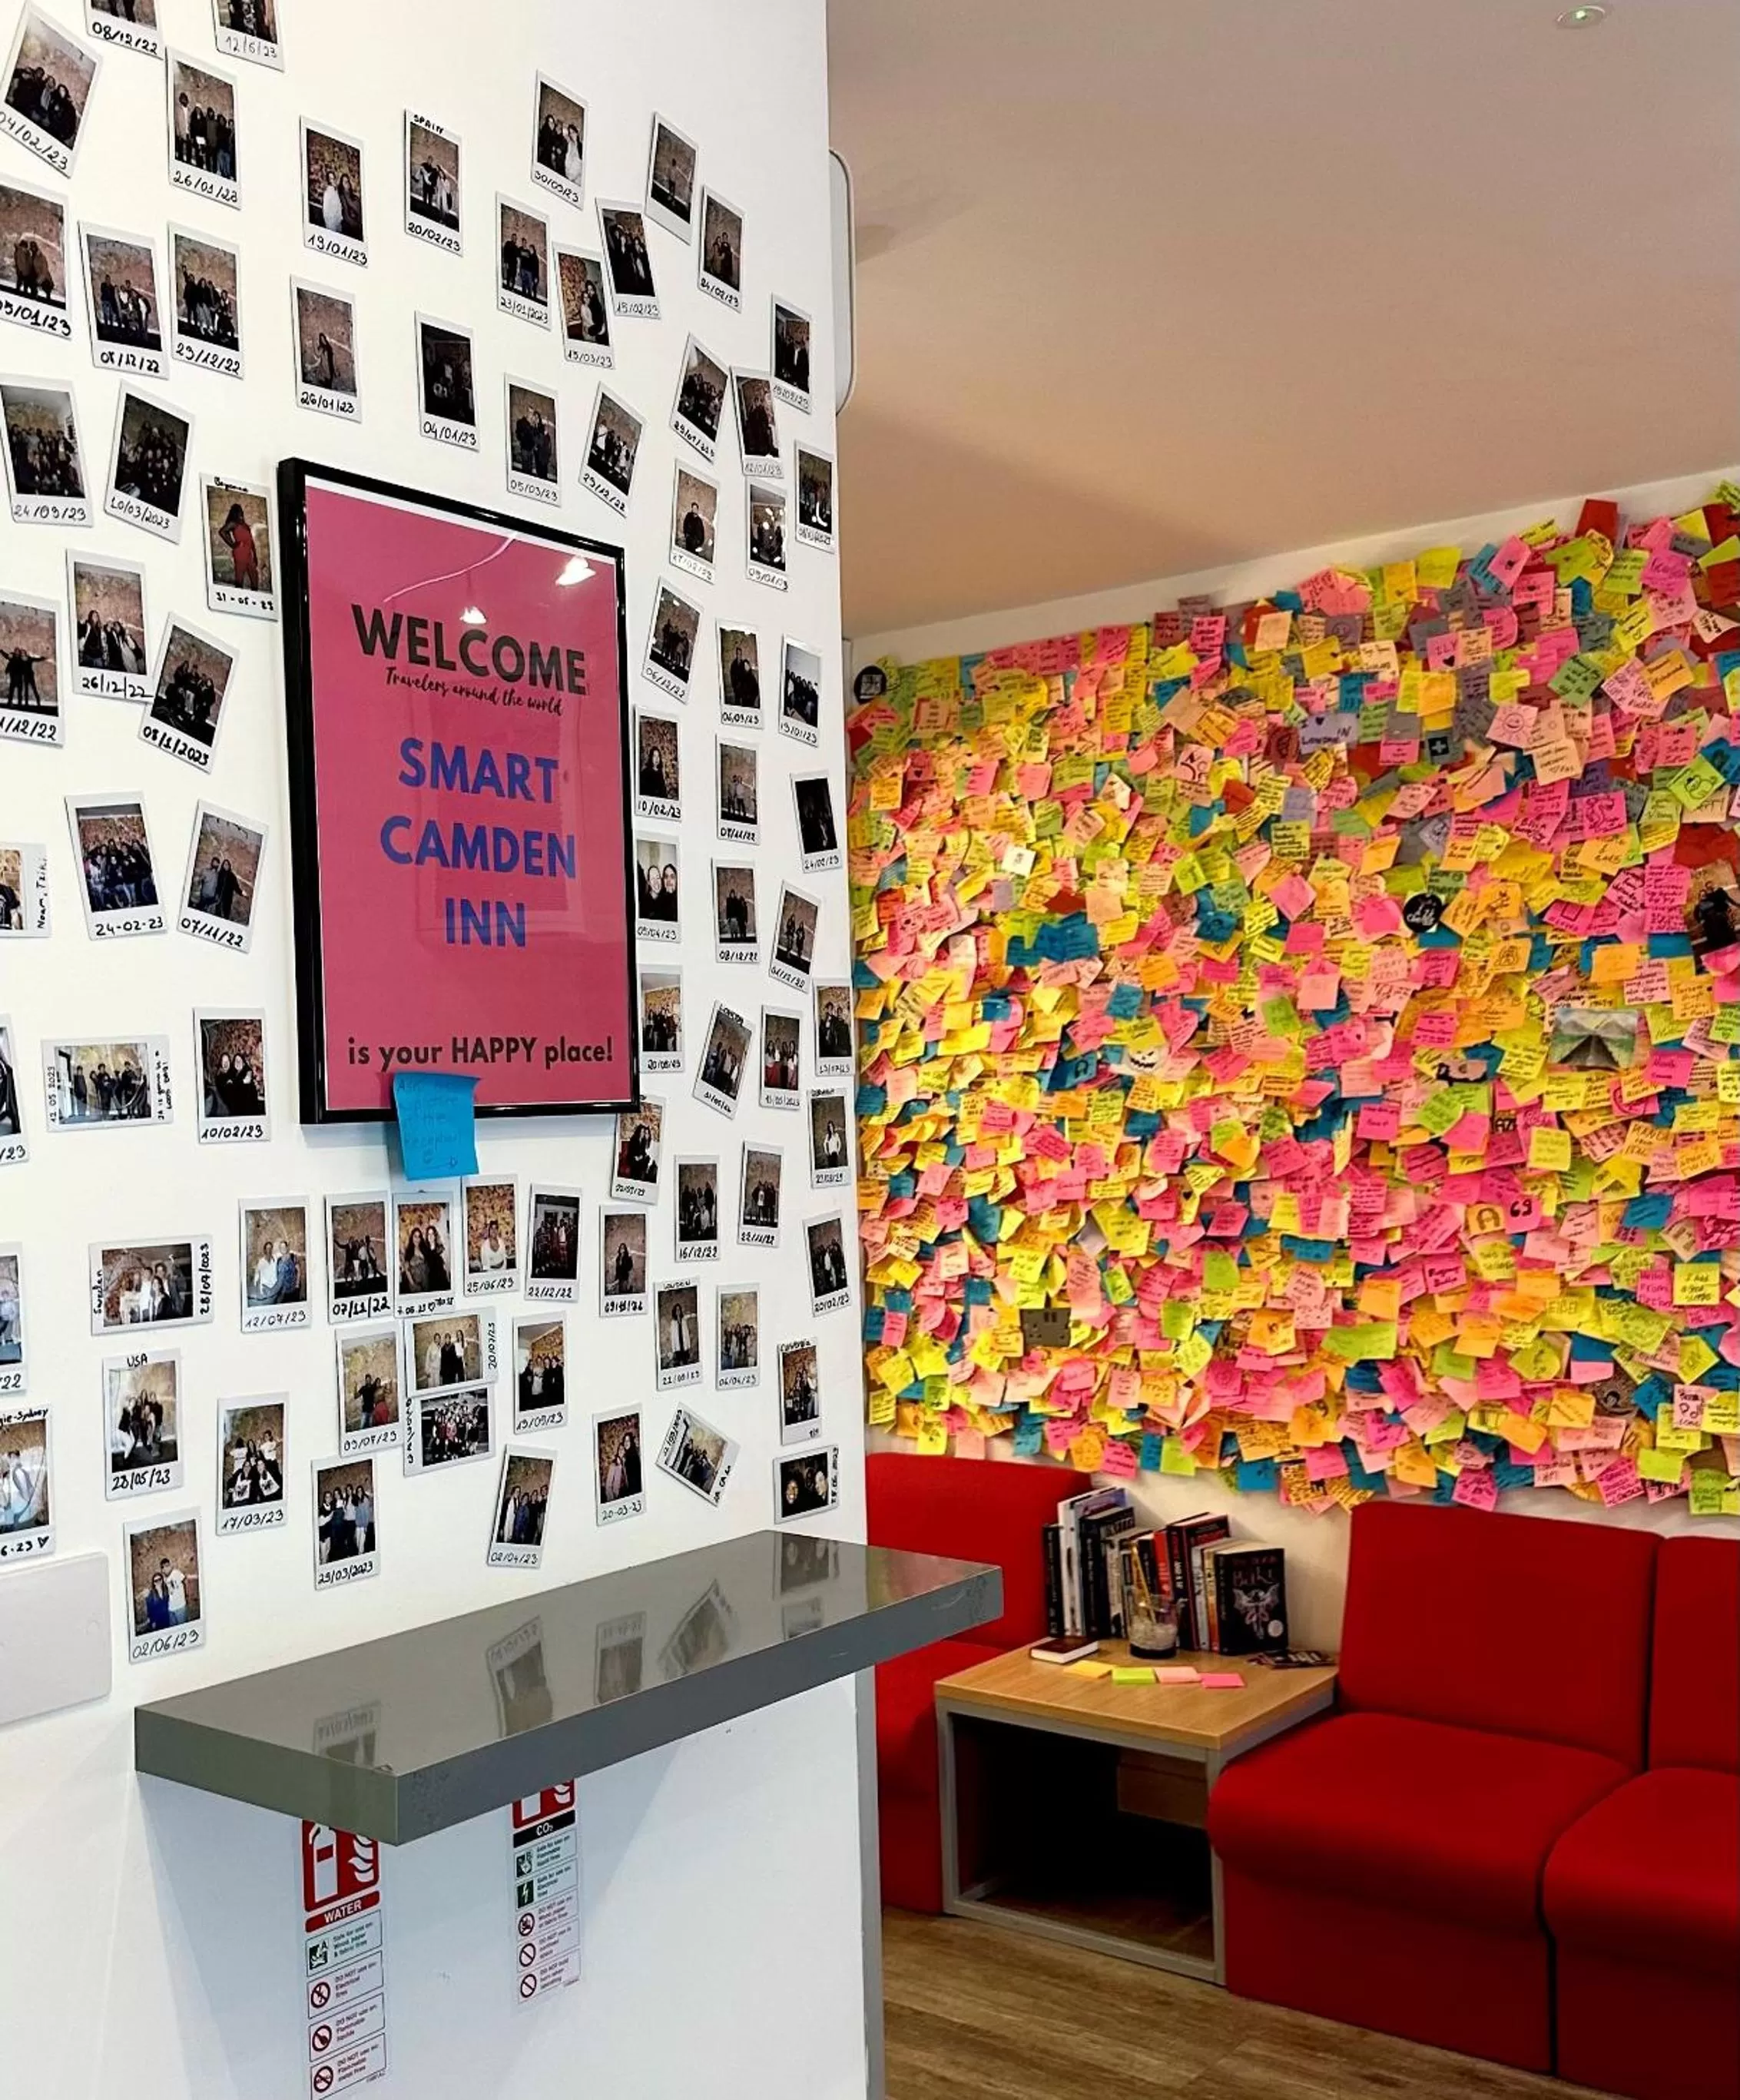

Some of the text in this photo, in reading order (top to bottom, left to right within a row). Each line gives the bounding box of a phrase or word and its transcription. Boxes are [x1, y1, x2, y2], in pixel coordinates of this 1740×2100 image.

[423, 421, 476, 446] 04/01/23
[351, 604, 586, 695] WELCOME
[386, 666, 450, 696] Travelers
[502, 689, 524, 707] the
[527, 697, 563, 715] world
[399, 737, 558, 803] SMART
[380, 816, 576, 879] CAMDEN
[445, 897, 526, 947] INN
[349, 1036, 613, 1072] is your HAPPY place!
[202, 1126, 263, 1139] 10/02/23
[127, 1353, 148, 1368] USA
[132, 1629, 199, 1659] 02/06/23
[323, 1899, 363, 1923] WATER
